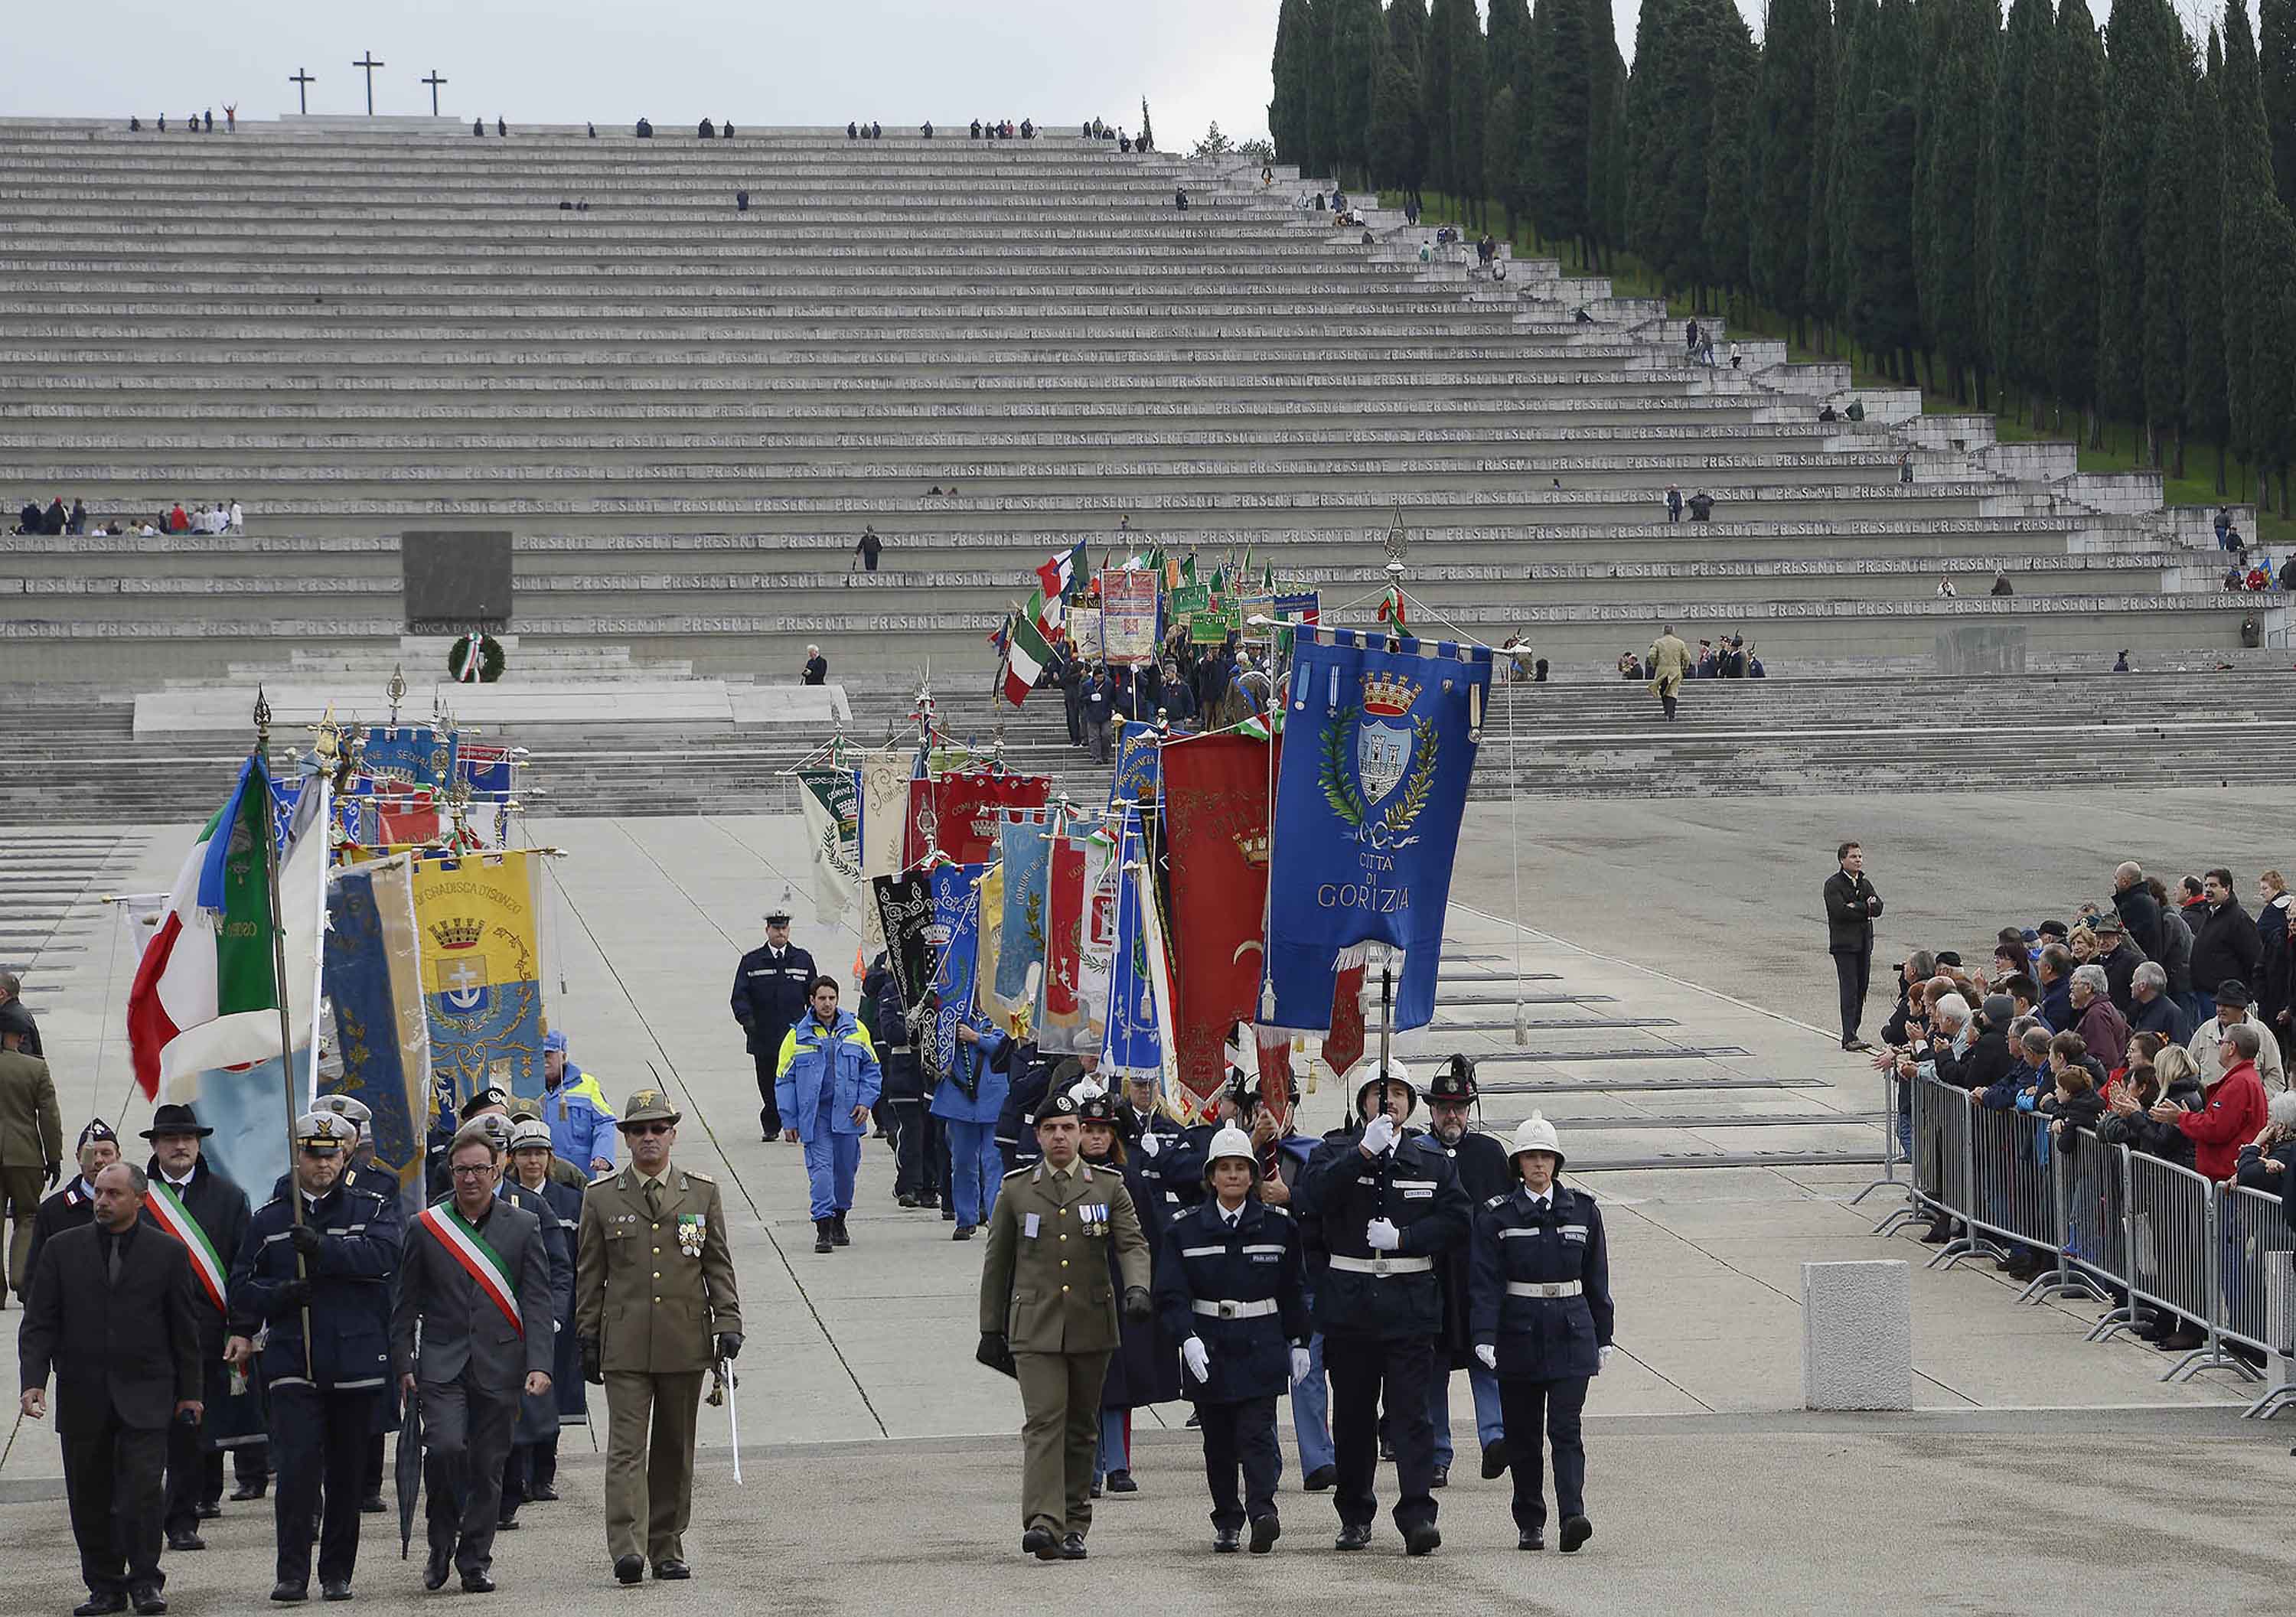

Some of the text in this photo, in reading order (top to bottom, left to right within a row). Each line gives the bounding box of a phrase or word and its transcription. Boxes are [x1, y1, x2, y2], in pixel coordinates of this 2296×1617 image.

[1003, 406, 1064, 416] PRESENTE
[1146, 405, 1206, 415] PRESENTE
[1216, 404, 1276, 415] PRESENTE
[1357, 402, 1416, 412] PRESENTE
[1427, 402, 1486, 412] PRESENTE
[1567, 399, 1626, 410] PRESENTE
[835, 435, 896, 446] PRESENTE
[908, 435, 970, 446] PRESENTE
[983, 435, 1045, 445] PRESENTE
[1056, 434, 1117, 445] PRESENTE
[1129, 434, 1190, 445] PRESENTE
[1202, 433, 1263, 444] PRESENTE
[1274, 432, 1335, 443] PRESENTE
[1346, 432, 1407, 442] PRESENTE
[1417, 431, 1479, 442] PRESENTE
[1488, 429, 1549, 441] PRESENTE
[1561, 429, 1620, 439] PRESENTE
[1632, 428, 1691, 438] PRESENTE
[865, 466, 931, 478] PRESENTE
[943, 466, 1008, 477] PRESENTE
[1021, 465, 1085, 477] PRESENTE
[1097, 464, 1161, 475] PRESENTE
[1174, 464, 1238, 474] PRESENTE
[1251, 463, 1313, 474] PRESENTE
[1326, 461, 1390, 473] PRESENTE
[1402, 461, 1465, 472] PRESENTE
[1552, 458, 1616, 470] PRESENTE
[1627, 458, 1691, 469] PRESENTE
[836, 500, 904, 511] PRESENTE
[916, 499, 983, 511] PRESENTE
[996, 498, 1064, 510] PRESENTE
[1076, 497, 1143, 509] PRESENTE
[1155, 497, 1221, 508] PRESENTE
[1234, 496, 1300, 507] PRESENTE
[1391, 494, 1456, 505] PRESENTE
[1466, 493, 1531, 505] PRESENTE
[1544, 492, 1610, 504] PRESENTE
[781, 534, 852, 547] PRESENTE
[951, 533, 1019, 546] PRESENTE
[1283, 530, 1351, 543] PRESENTE
[1447, 527, 1515, 540] PRESENTE
[1529, 526, 1596, 539] PRESENTE
[1610, 524, 1677, 538] PRESENTE
[1852, 521, 1919, 534] PRESENTE
[926, 572, 999, 586] PRESENTE
[1438, 566, 1508, 580] PRESENTE
[1607, 564, 1677, 578] PRESENTE
[1773, 561, 1843, 575] PRESENTE
[1857, 559, 1926, 573] PRESENTE
[1502, 607, 1577, 621] PRESENTE
[1590, 605, 1665, 619] PRESENTE
[1680, 604, 1754, 618] PRESENTE
[1769, 602, 1842, 616] PRESENTE
[1857, 601, 1930, 615] PRESENTE
[2033, 598, 2105, 611] PRESENTE
[1366, 872, 1376, 885] DI
[425, 881, 478, 901] GRADISCA
[1317, 884, 1410, 913] GORIZIA
[902, 916, 928, 940] COMUNE
